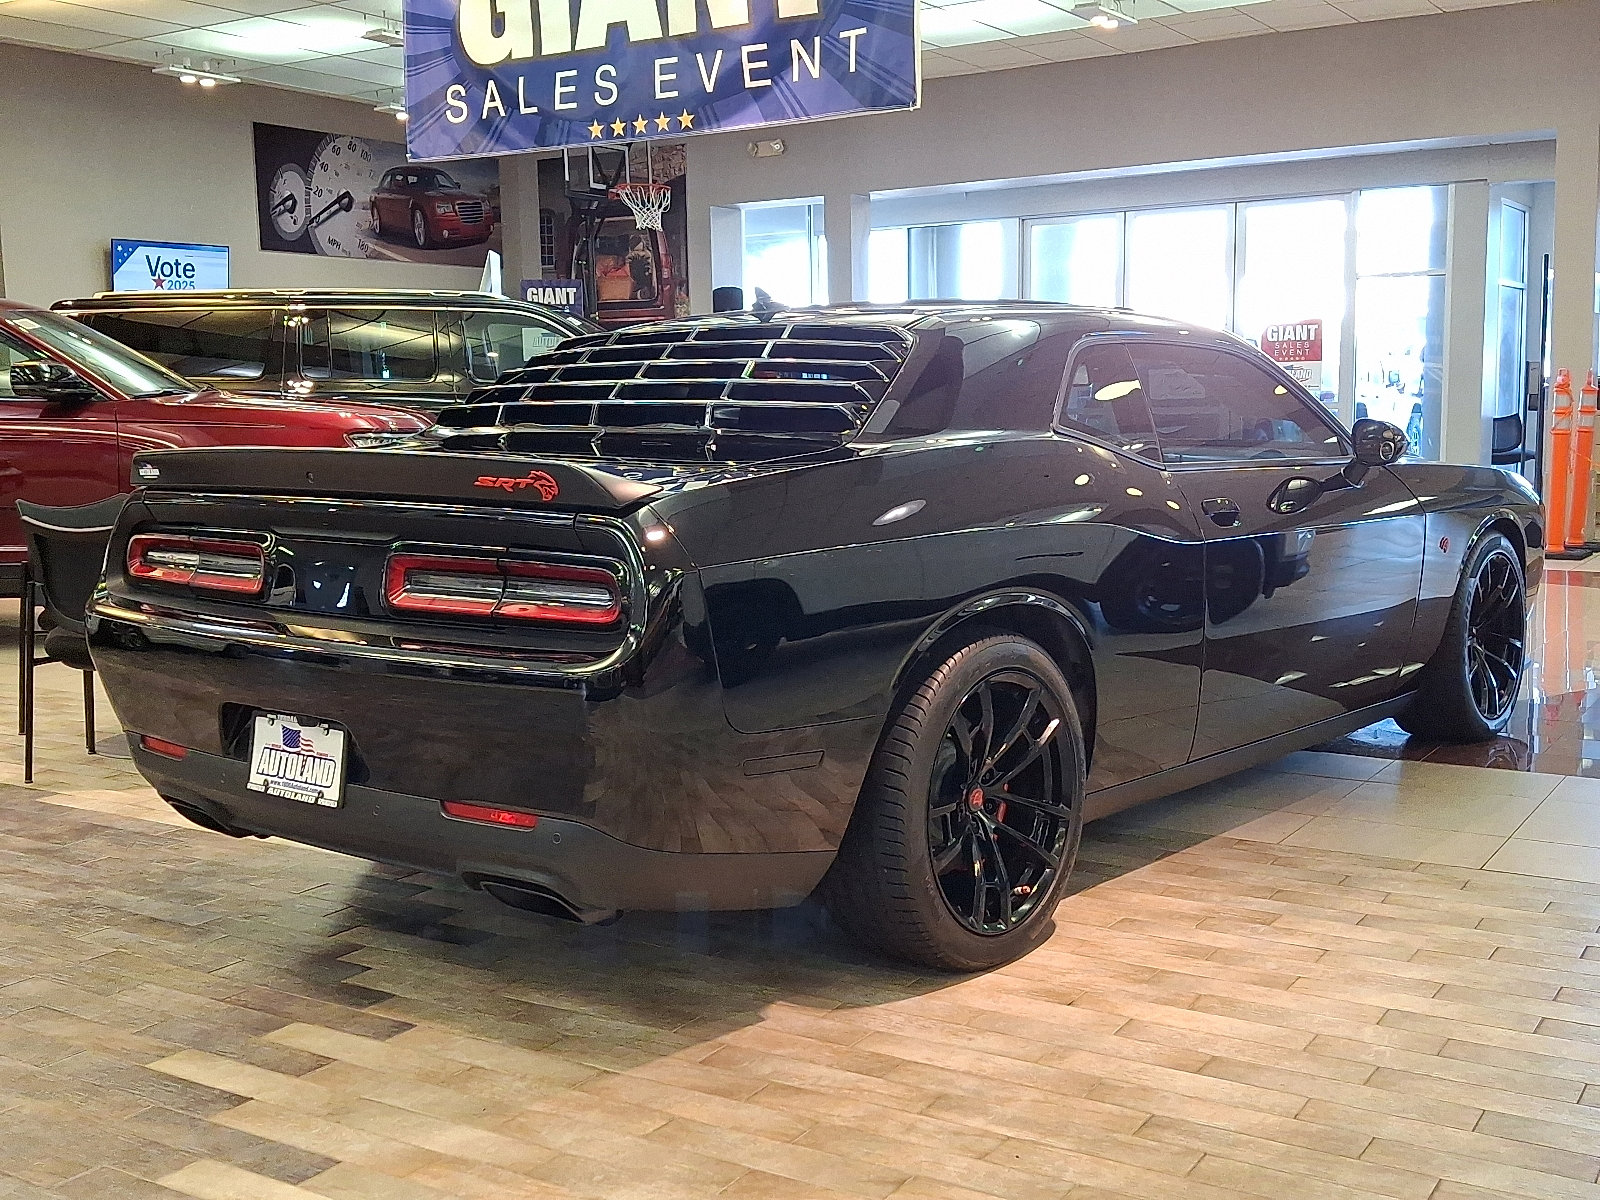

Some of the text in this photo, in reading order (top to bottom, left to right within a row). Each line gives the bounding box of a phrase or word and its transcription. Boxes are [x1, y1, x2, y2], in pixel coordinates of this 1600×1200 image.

[445, 27, 868, 125] SALES EVENT
[331, 144, 341, 156] 60
[347, 140, 357, 153] 80
[360, 149, 372, 163] 100
[319, 161, 329, 173] 40
[313, 185, 323, 198] 20
[145, 254, 196, 279] Vote
[167, 279, 196, 290] 2025
[526, 287, 577, 305] GIANT
[1266, 324, 1319, 342] GIANT
[1274, 341, 1310, 349] SALES
[1274, 348, 1310, 357] EVENT
[473, 476, 535, 493] SRT
[256, 747, 336, 788] AUTOLAND
[266, 786, 317, 804] AUTOLAND
